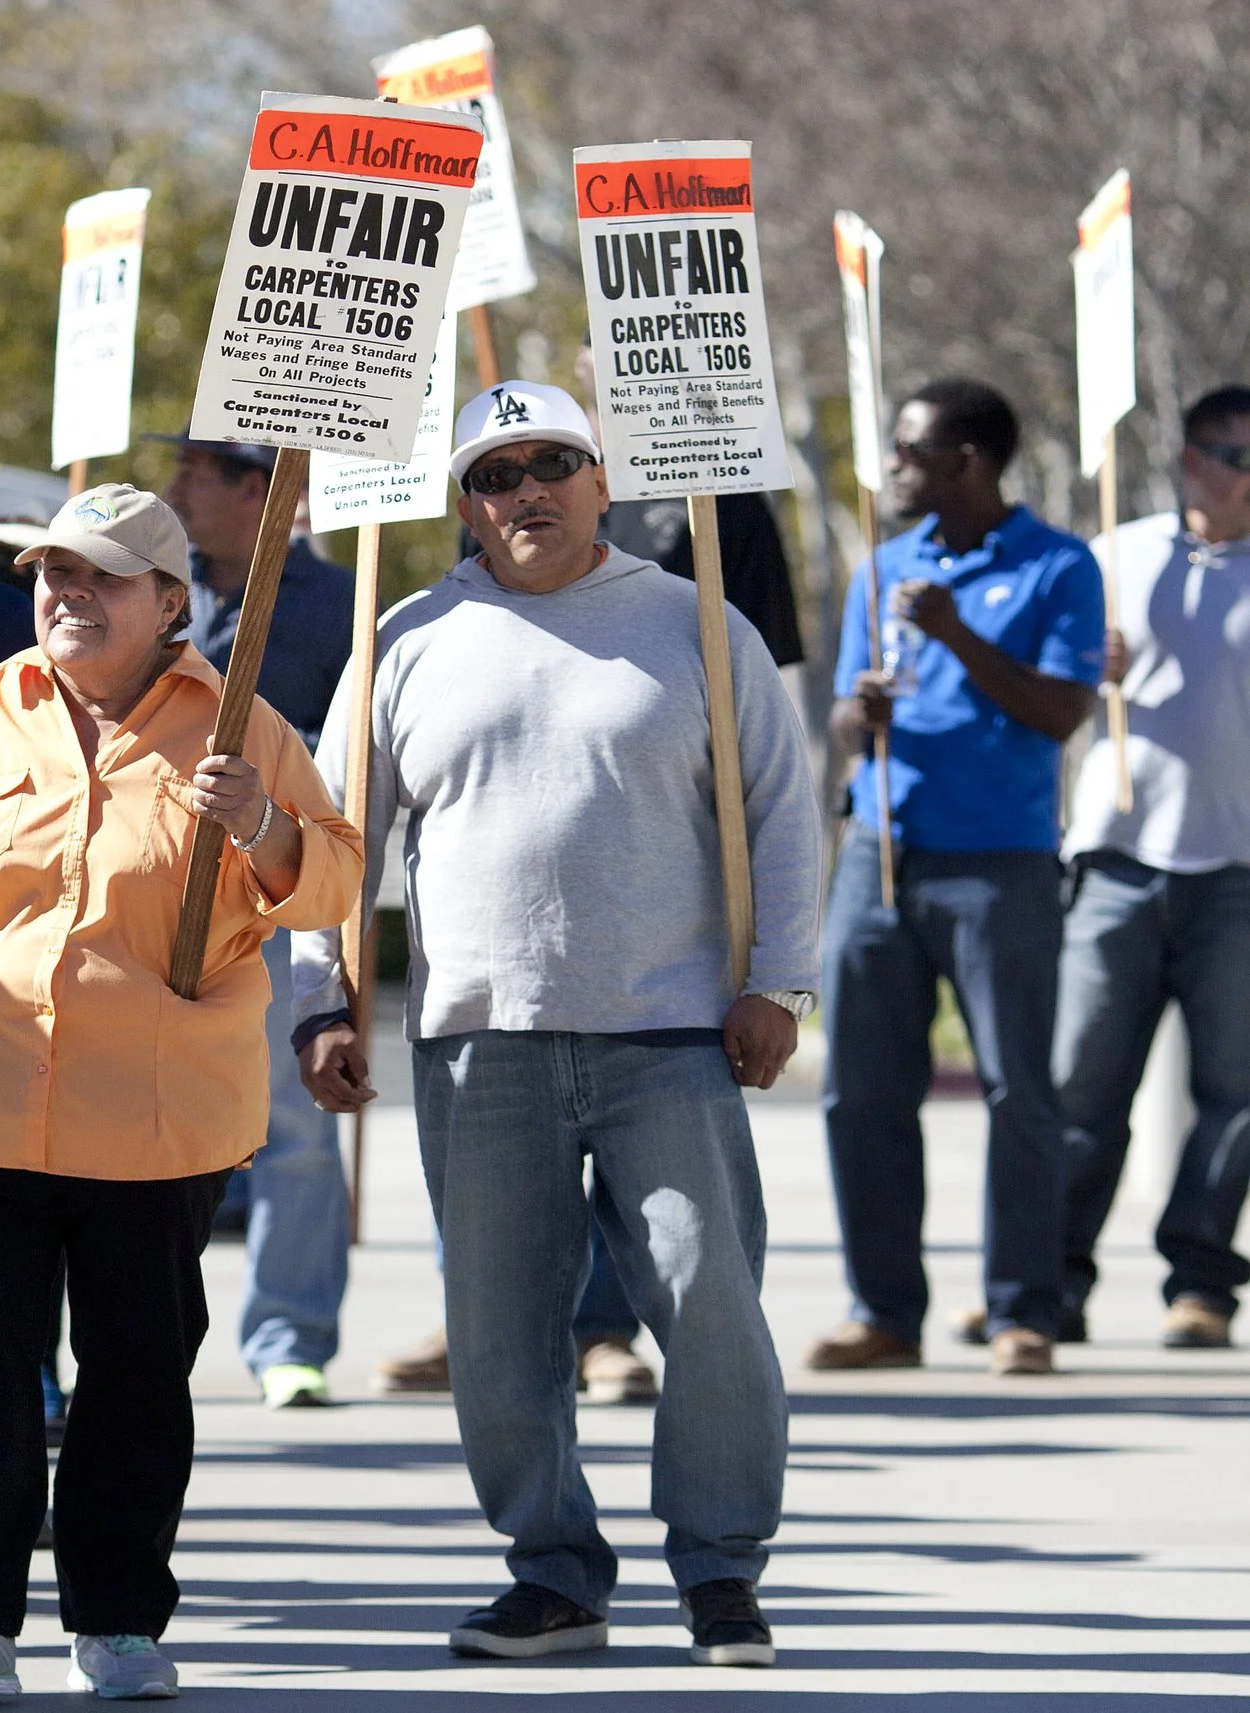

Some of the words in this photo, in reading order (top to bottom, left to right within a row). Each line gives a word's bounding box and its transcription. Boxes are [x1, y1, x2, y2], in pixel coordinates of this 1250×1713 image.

[347, 128, 479, 180] Hoffman
[654, 171, 751, 210] Hoffman
[248, 181, 446, 268] UNFAIR
[325, 258, 348, 269] to
[595, 228, 750, 300] UNFAIR
[244, 264, 420, 309] CARPENTERS
[674, 301, 692, 310] to
[237, 296, 322, 330] LOCAL
[337, 306, 414, 341] #1506
[611, 311, 747, 344] CARPENTERS
[223, 329, 249, 343] Not
[256, 333, 304, 350] Paying
[311, 339, 344, 353] Area
[350, 344, 417, 363] Standard
[220, 345, 267, 361] Wages
[273, 352, 299, 364] and
[305, 354, 349, 371] Fringe
[355, 360, 413, 379] Benefits
[614, 346, 689, 377] LOCAL
[697, 344, 751, 371] #1506
[259, 366, 276, 378] On
[282, 369, 303, 381] All
[309, 371, 367, 389] Projects
[610, 387, 632, 398] Not
[638, 383, 680, 397] Paying
[686, 381, 712, 393] Area
[715, 379, 763, 391] Standard
[252, 390, 338, 407] Sanctioned
[342, 399, 362, 411] by
[611, 403, 652, 415] Wages
[658, 400, 680, 411] and
[686, 397, 719, 410] Fringe
[722, 395, 765, 408] Benefits
[223, 400, 331, 421] Carpenters
[337, 412, 390, 430] Local
[650, 417, 665, 428] On
[671, 414, 688, 426] All
[693, 413, 735, 426] Projects
[237, 417, 298, 433] Union
[307, 425, 367, 443] #1506
[651, 437, 721, 450] Sanctioned
[723, 437, 737, 447] by
[629, 453, 720, 467] Carpenters
[723, 447, 763, 461] Local
[339, 463, 390, 477] Sanctioned
[646, 469, 699, 482] Union
[324, 480, 385, 495] Carpenters
[391, 473, 427, 486] Local
[334, 498, 368, 510] Union
[380, 493, 411, 504] 1506
